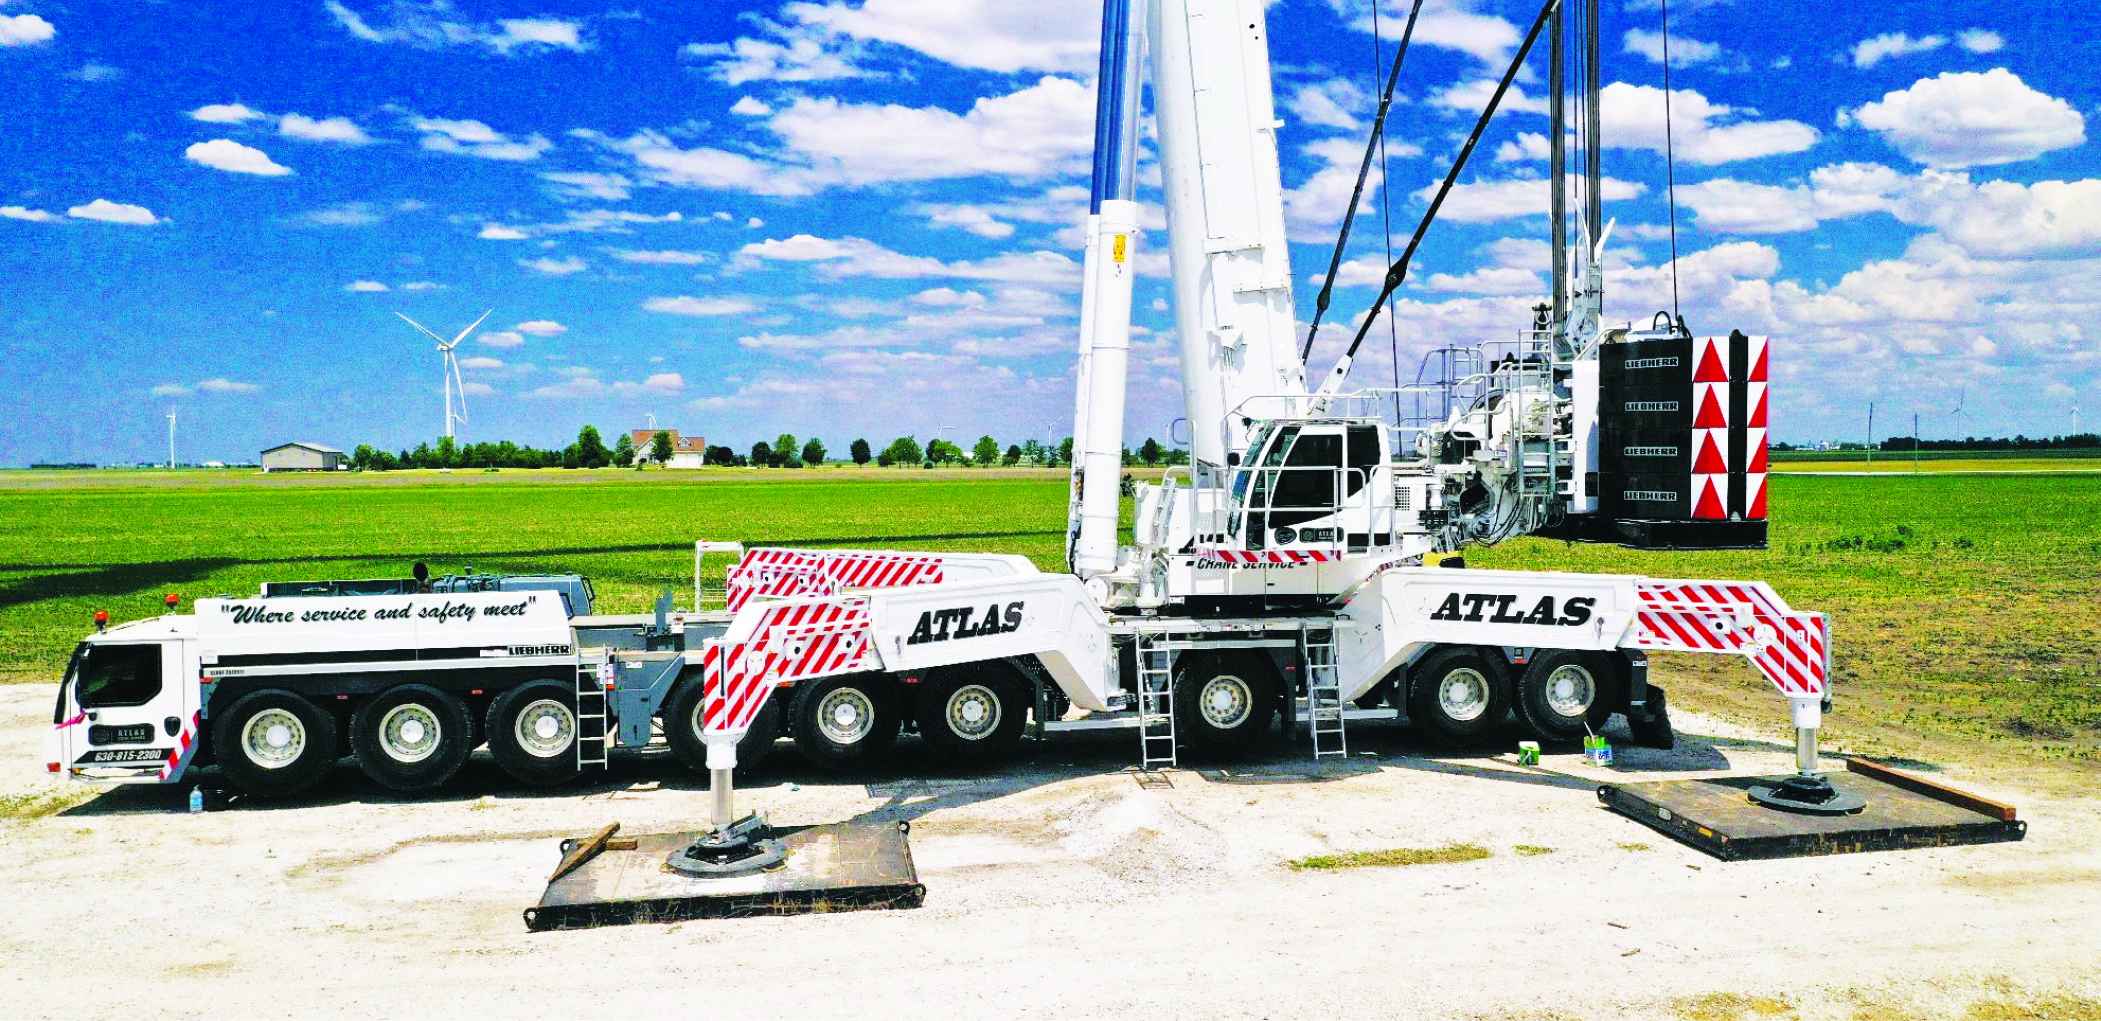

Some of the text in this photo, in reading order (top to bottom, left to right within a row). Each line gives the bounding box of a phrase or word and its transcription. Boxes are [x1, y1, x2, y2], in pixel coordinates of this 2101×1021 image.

[1625, 358, 1678, 368] LIEBHERR
[1625, 402, 1678, 411] LIEBHERR
[1624, 447, 1677, 456] LIEBHERR
[1624, 491, 1676, 501] LIEBHERR
[301, 607, 367, 622] service
[374, 602, 413, 620] and
[417, 601, 476, 624] safety
[1430, 593, 1596, 626] ATLAS
[907, 601, 1024, 645] ATLAS
[508, 645, 570, 656] LIEBHERR
[94, 750, 162, 762] 630-815-2300
